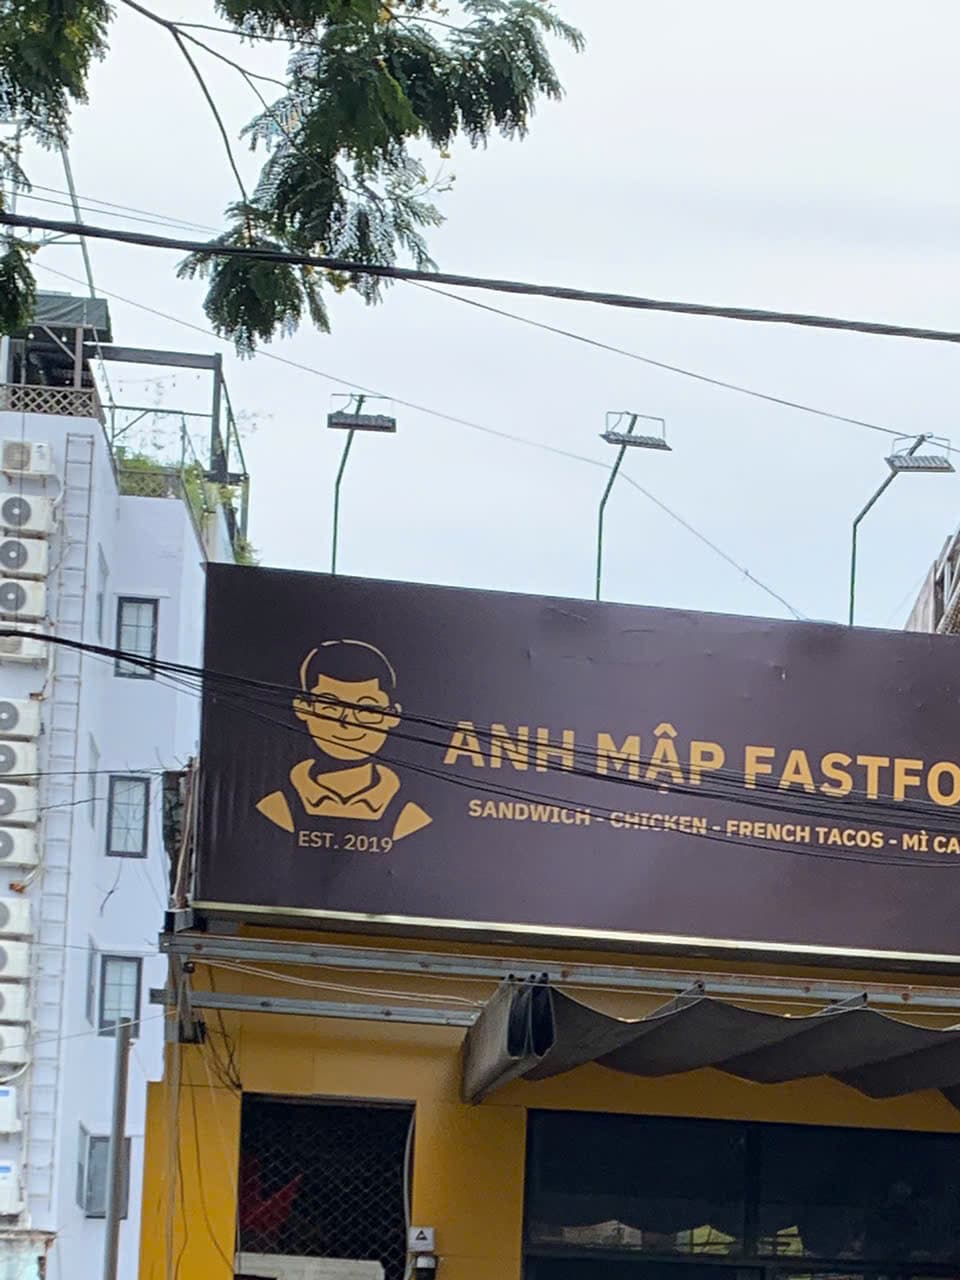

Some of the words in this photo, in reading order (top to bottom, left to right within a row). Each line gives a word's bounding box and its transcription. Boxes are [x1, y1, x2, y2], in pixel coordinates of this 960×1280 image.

[443, 720, 575, 773] ANH
[596, 722, 726, 794] MẬP
[298, 831, 339, 849] EST.
[344, 834, 393, 853] 2019
[469, 800, 591, 826] SANDWICH
[610, 811, 707, 835] CHICKEN
[725, 819, 811, 844] FRENCH
[816, 826, 884, 849] TACOS
[902, 829, 929, 852] MÌ
